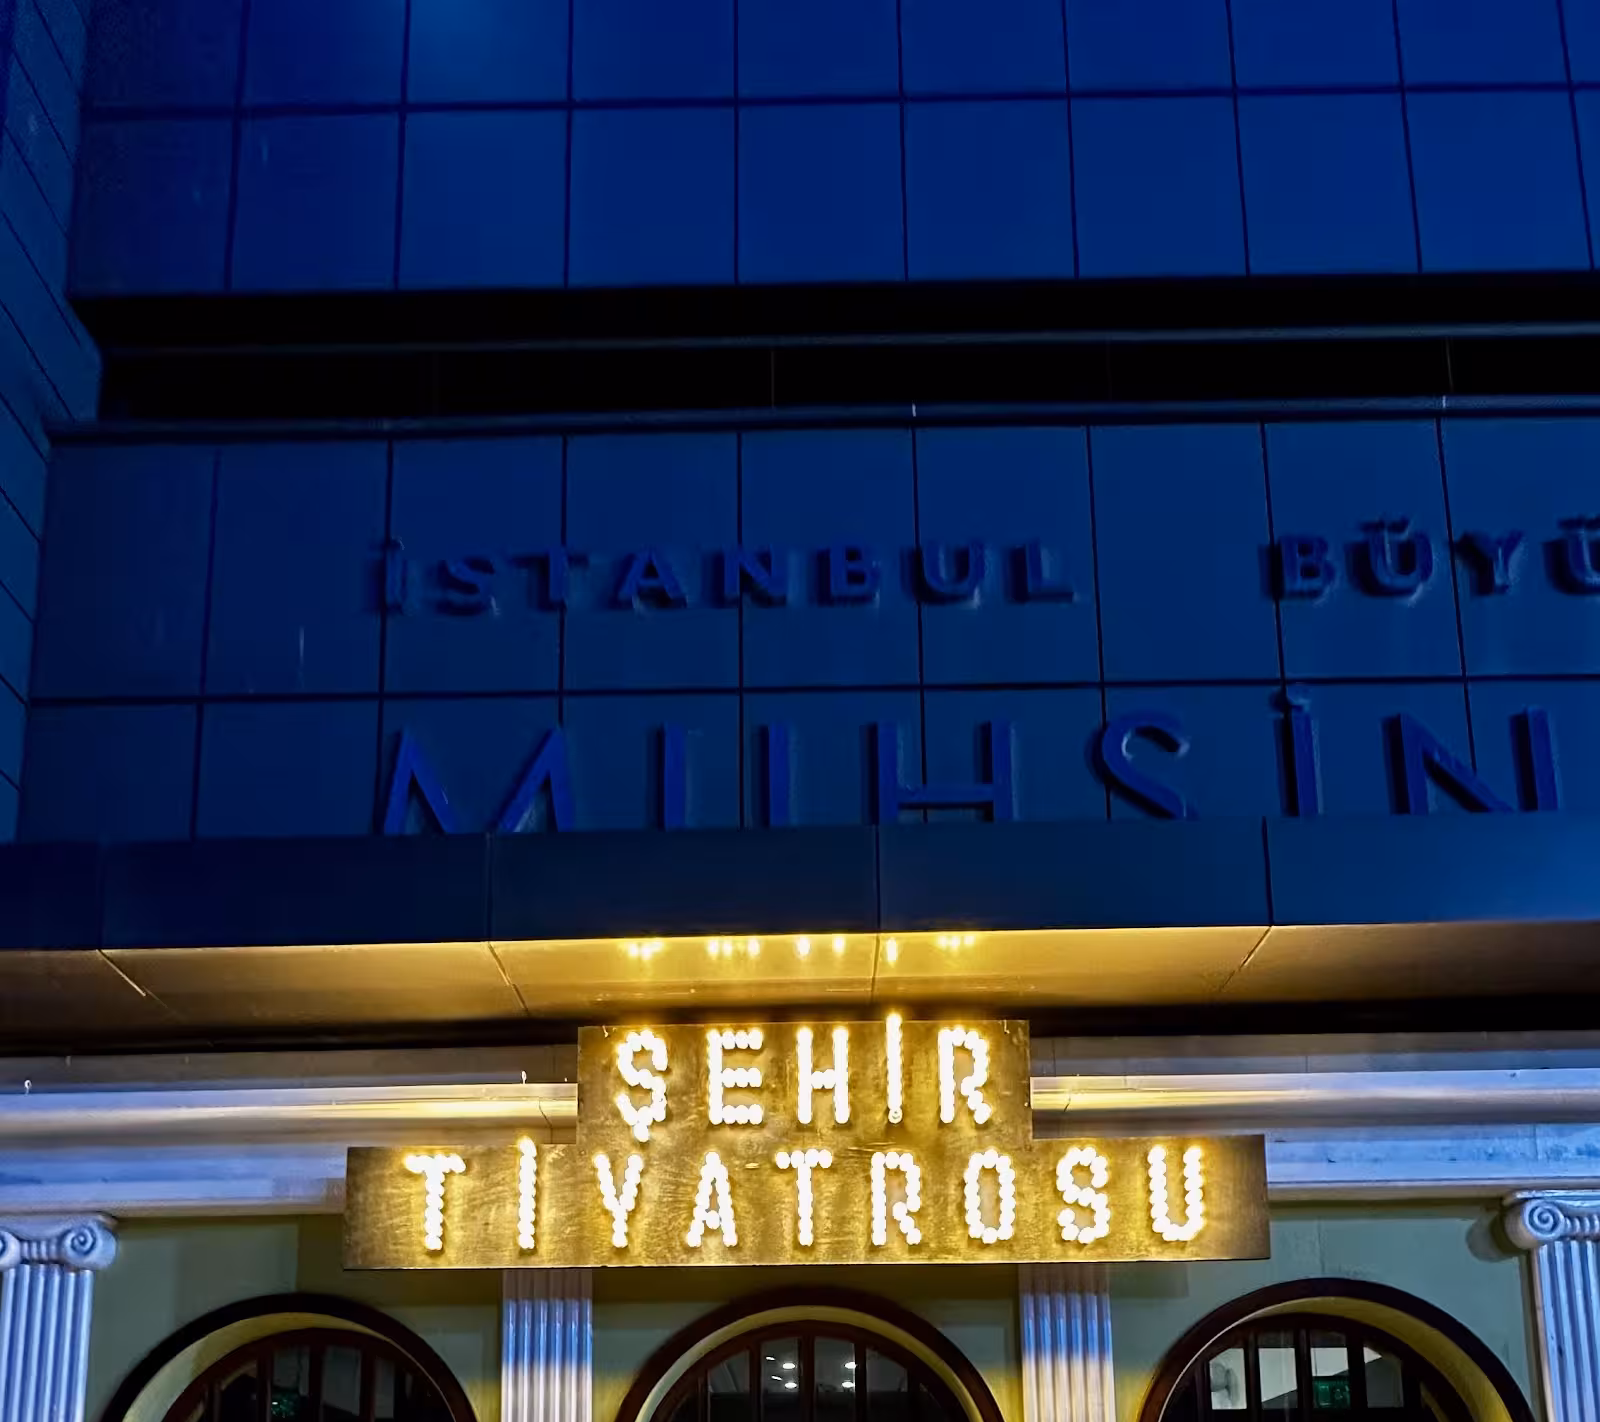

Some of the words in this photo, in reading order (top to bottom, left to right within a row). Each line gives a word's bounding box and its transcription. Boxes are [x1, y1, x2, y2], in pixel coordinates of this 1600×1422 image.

[368, 539, 1085, 616] İSTANBUL
[614, 1012, 994, 1143] ŞEHİR
[404, 1137, 1206, 1252] TİYATROSU
